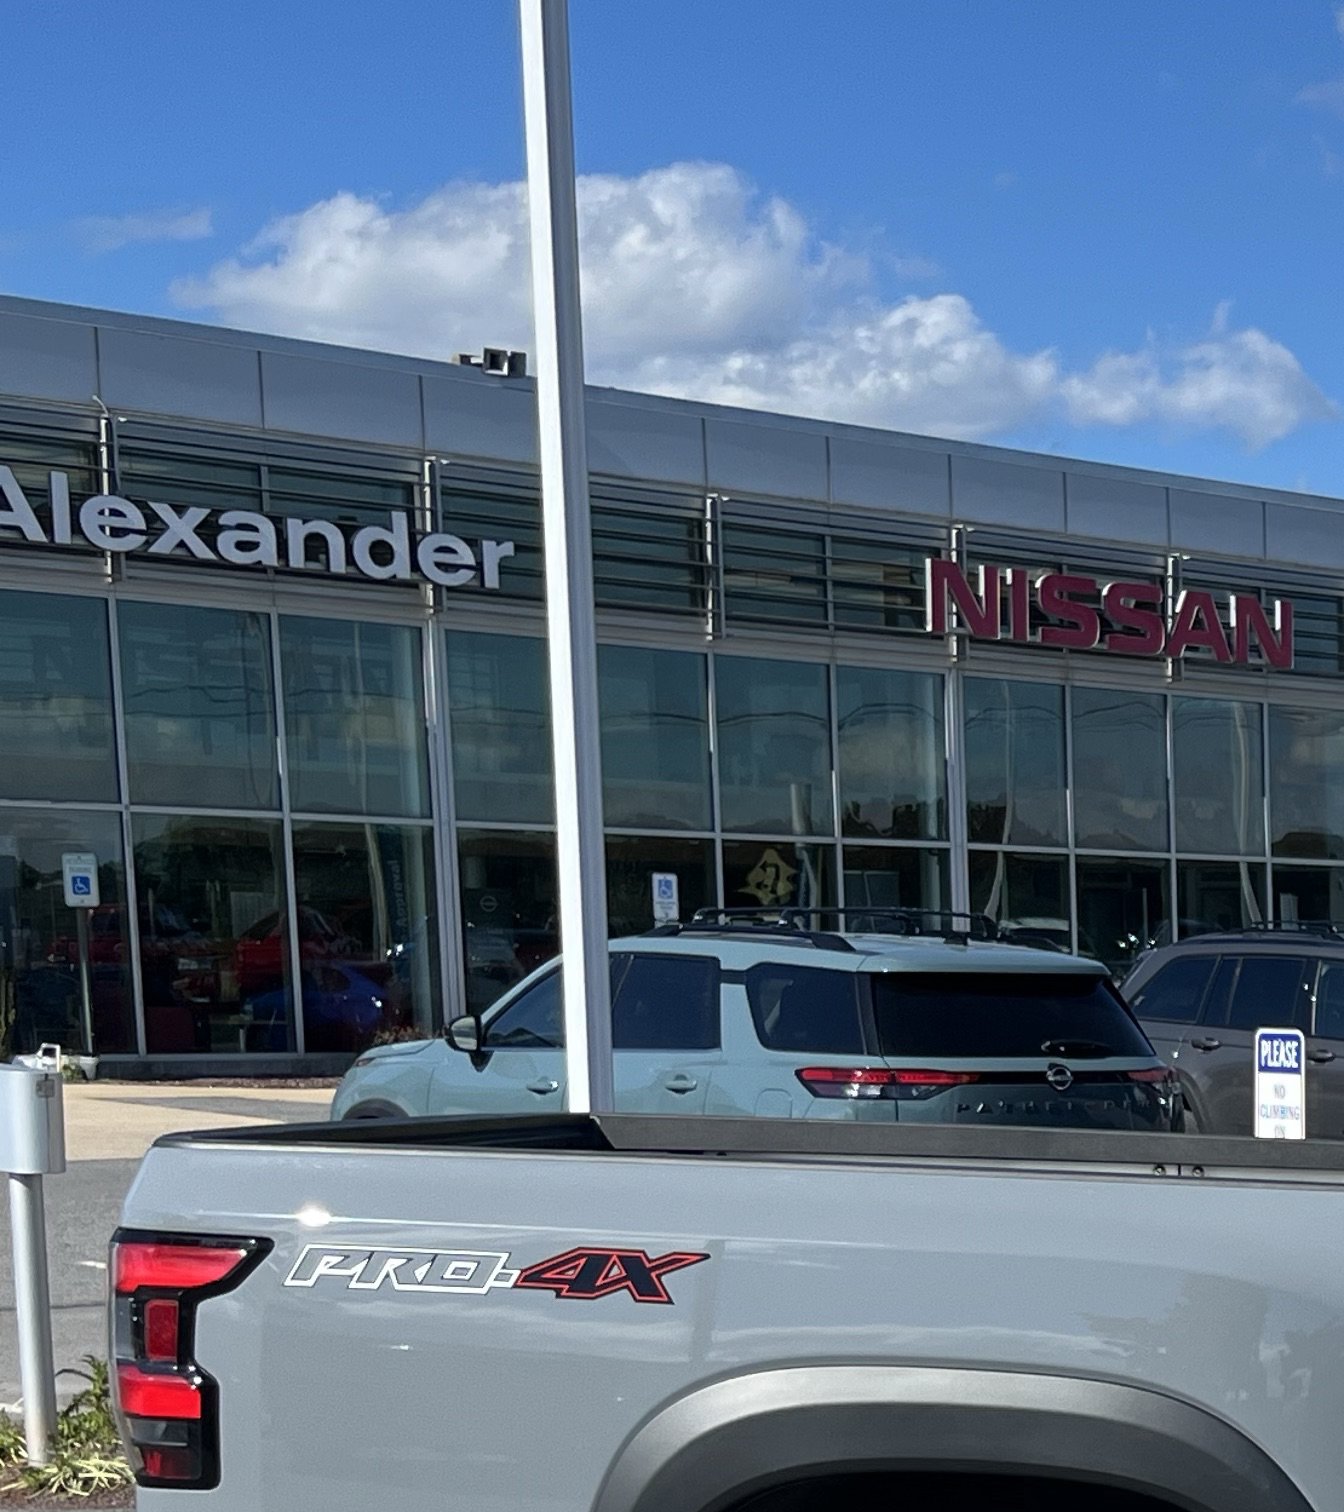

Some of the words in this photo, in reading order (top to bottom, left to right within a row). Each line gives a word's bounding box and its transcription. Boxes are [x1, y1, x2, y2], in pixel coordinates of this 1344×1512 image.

[926, 558, 1293, 669] NISSAN
[1261, 1039, 1299, 1068] PLEASE
[1273, 1084, 1286, 1099] NO
[1260, 1104, 1300, 1120] CLIMBING
